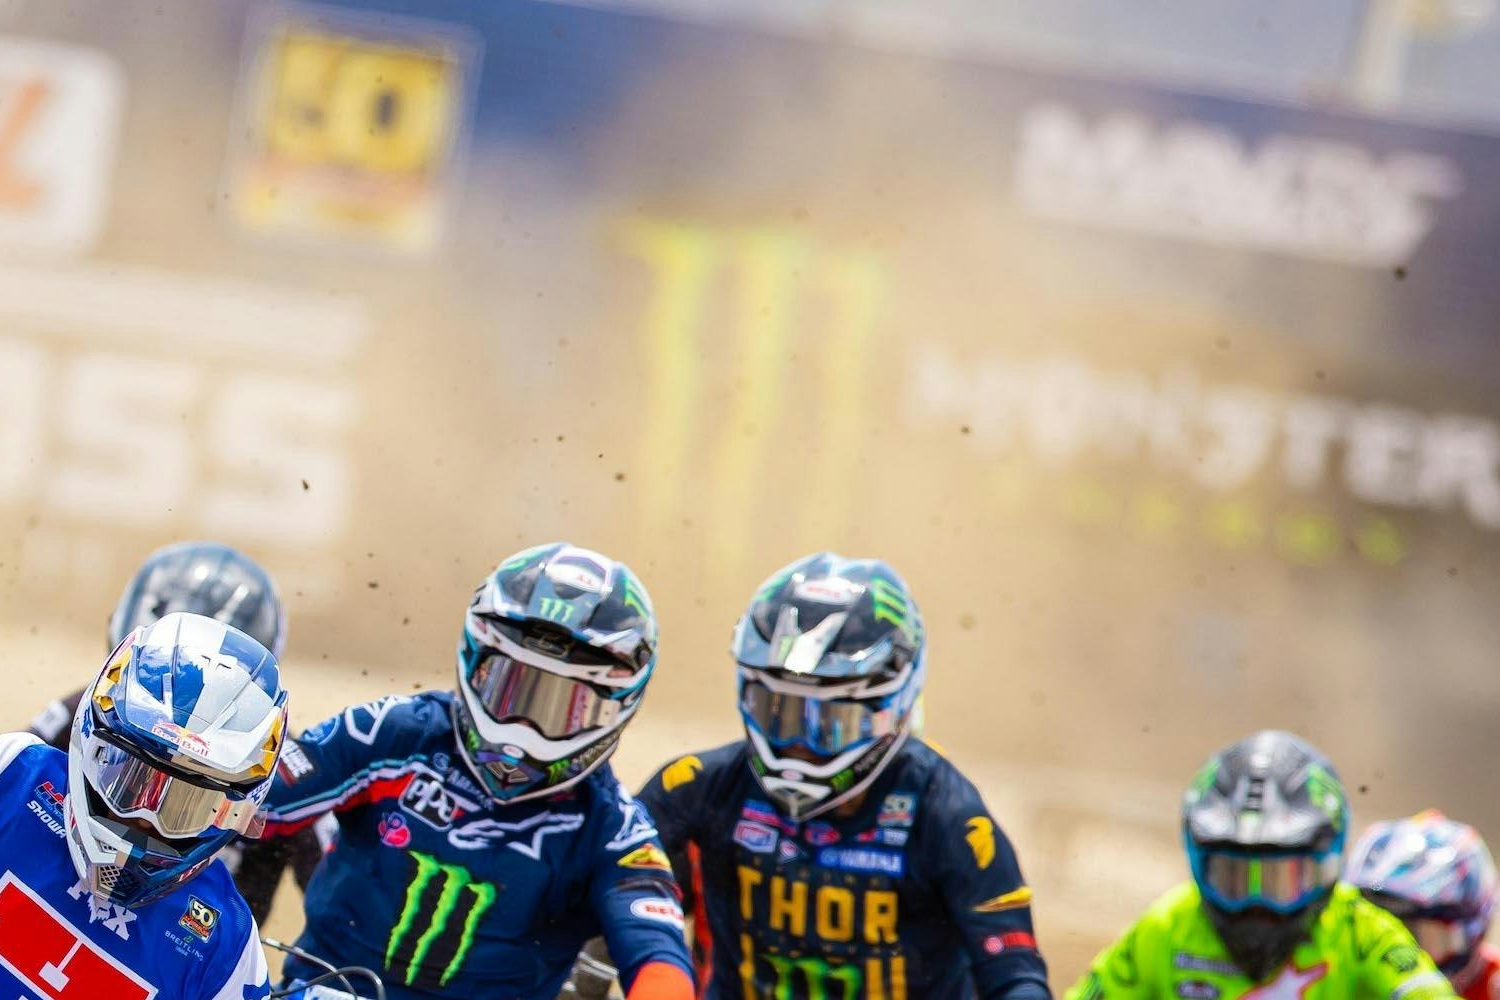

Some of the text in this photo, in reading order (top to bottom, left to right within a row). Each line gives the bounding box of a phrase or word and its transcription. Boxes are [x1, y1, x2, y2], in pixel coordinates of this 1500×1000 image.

[151, 727, 210, 757] Red Bull
[736, 865, 899, 945] THOR
